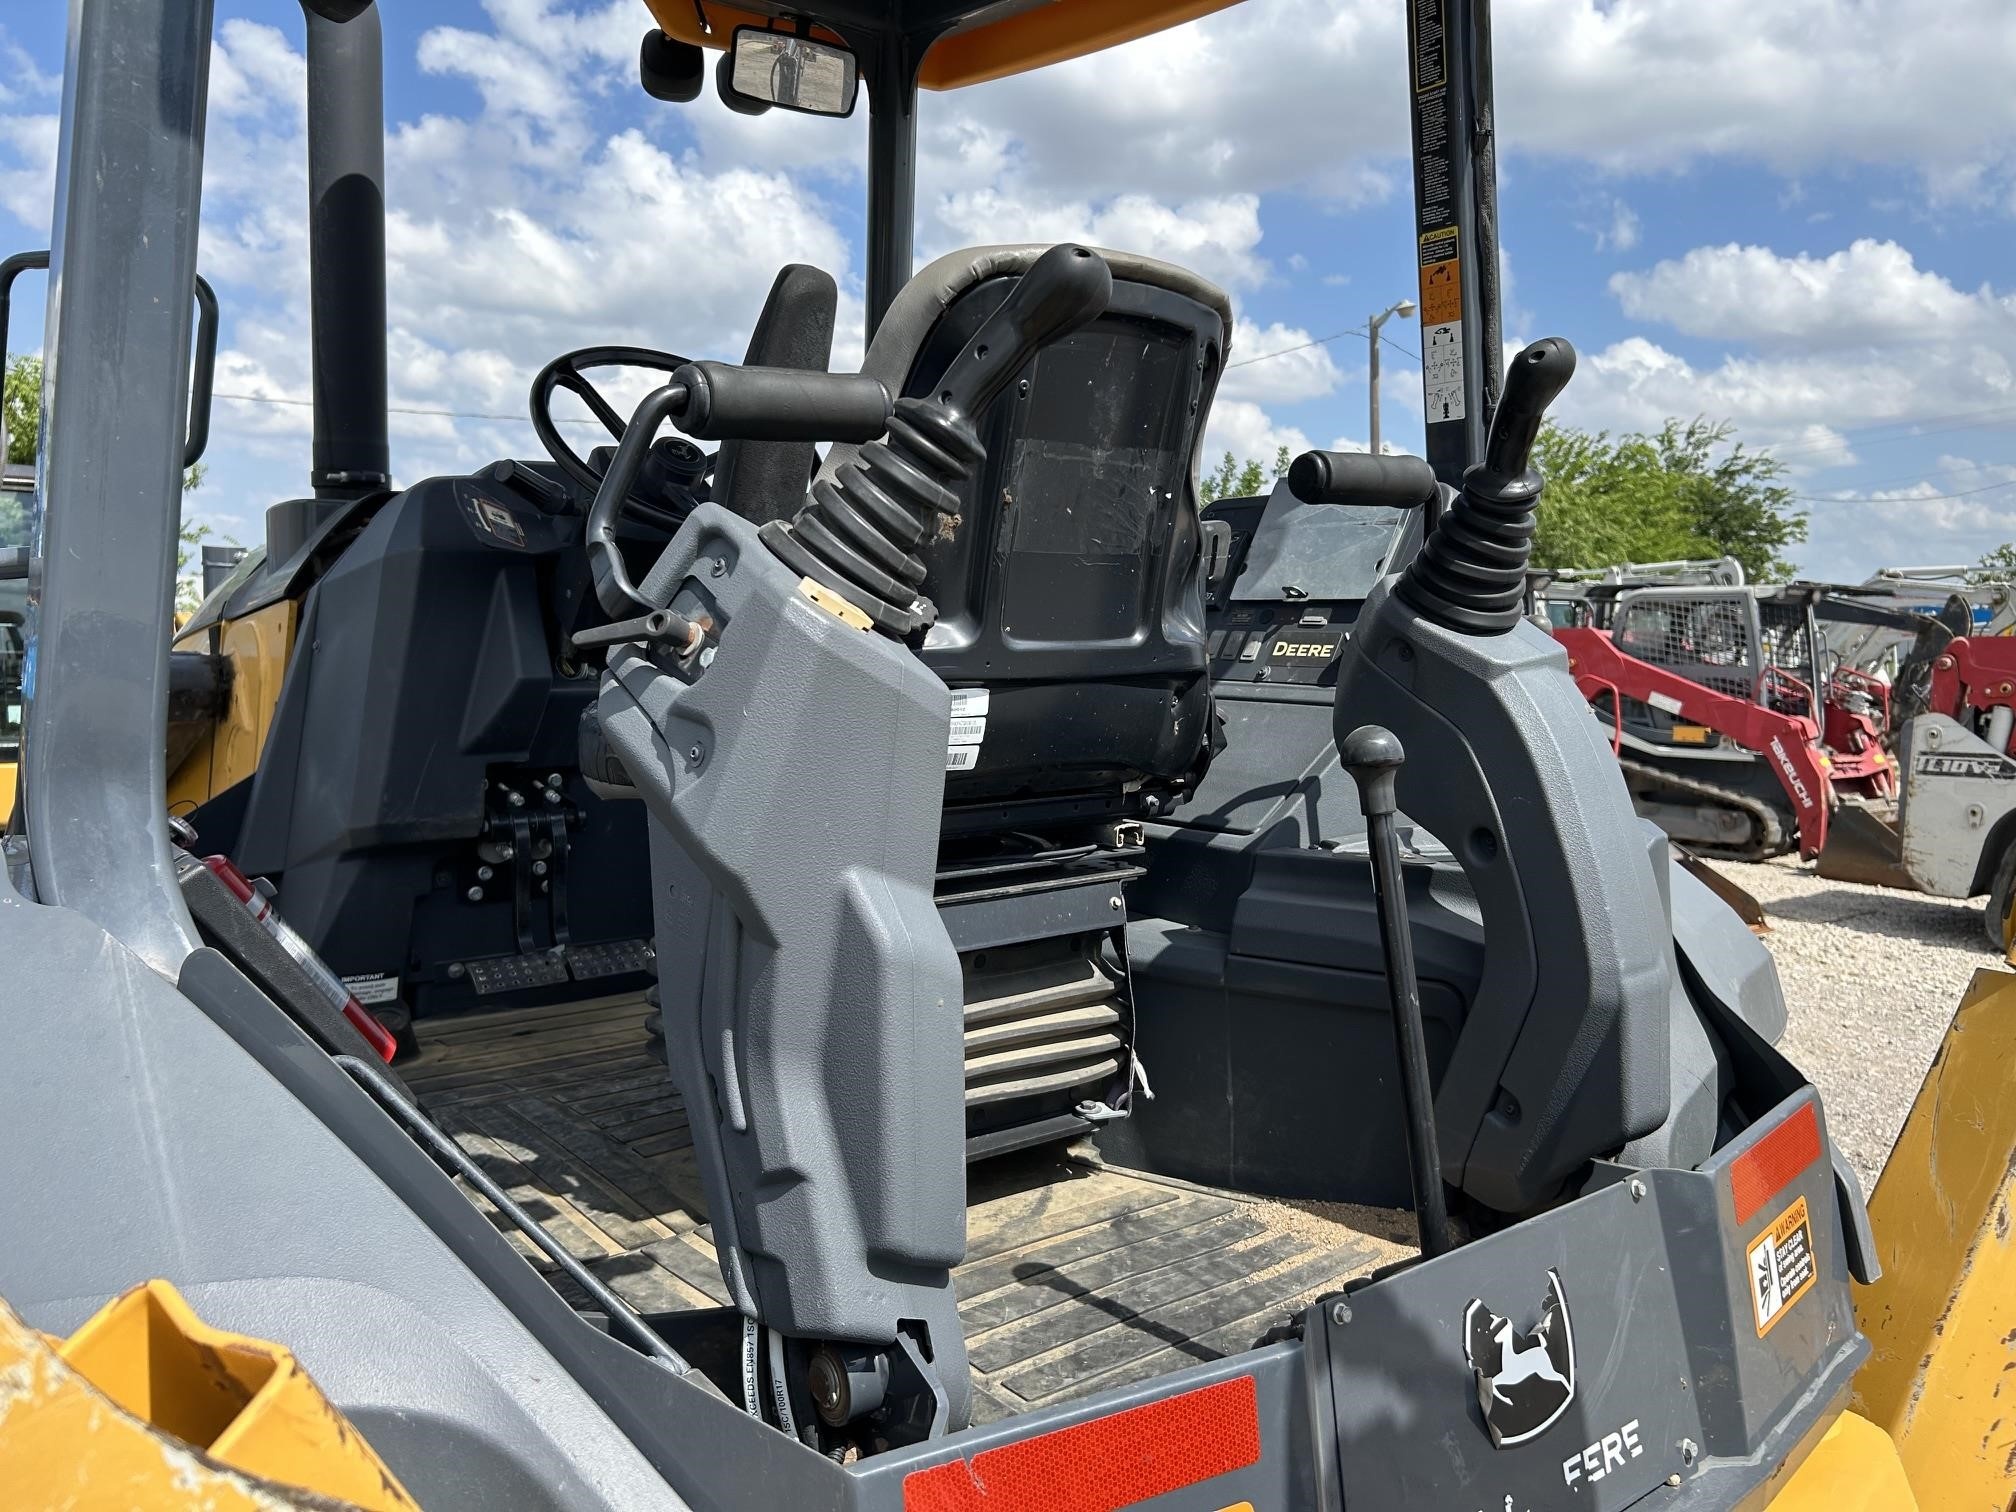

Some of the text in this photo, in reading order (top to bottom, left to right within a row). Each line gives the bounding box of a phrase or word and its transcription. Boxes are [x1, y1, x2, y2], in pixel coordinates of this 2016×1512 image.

[1428, 229, 1455, 243] CAUTION
[1272, 641, 1335, 658] DEERE
[1770, 735, 1814, 808] TAKEUCHI
[341, 972, 385, 983] IMPORTANT
[1779, 1203, 1806, 1237] WARNING
[1776, 1229, 1803, 1261] STAY CLEAR
[746, 1341, 756, 1374] EN857
[775, 1379, 792, 1433] 1SC/100R17
